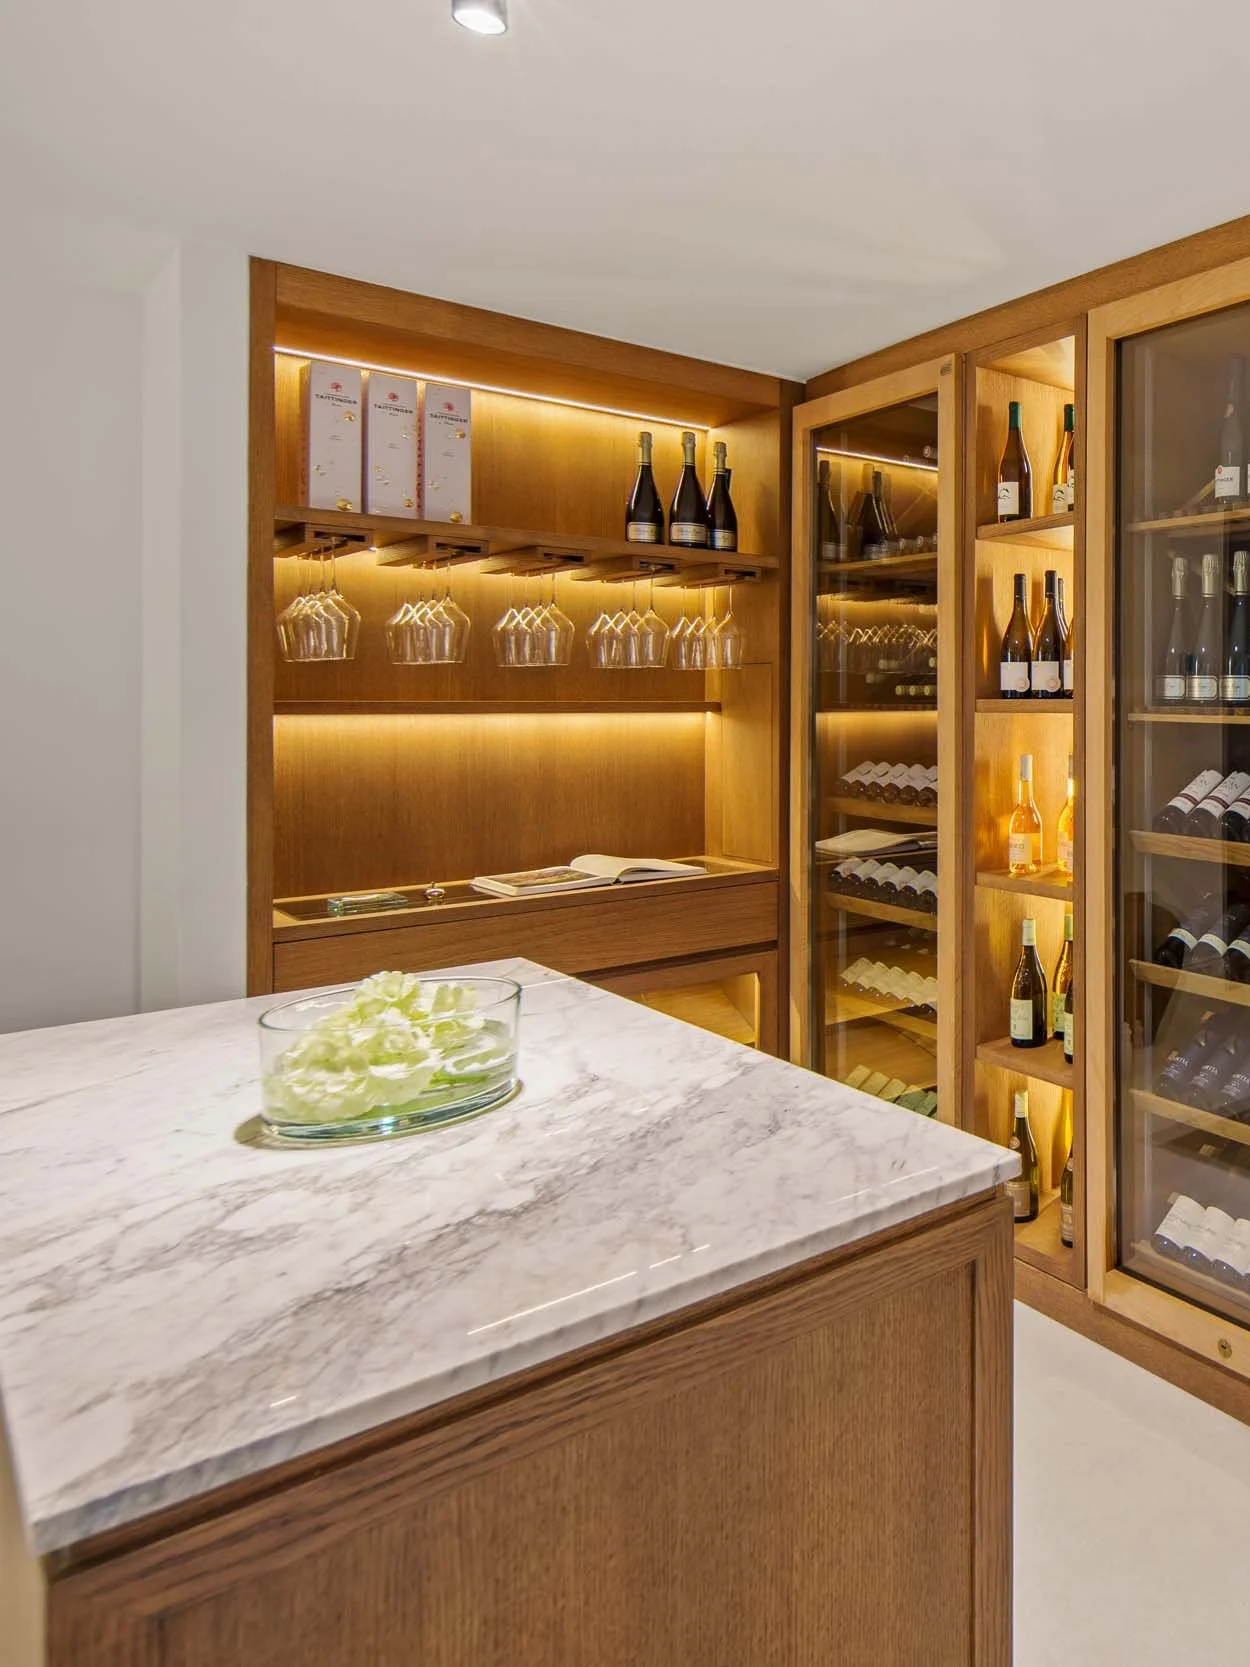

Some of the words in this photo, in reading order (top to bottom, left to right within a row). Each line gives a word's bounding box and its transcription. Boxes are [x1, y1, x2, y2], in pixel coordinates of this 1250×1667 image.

[315, 394, 357, 405] TAITTINGER
[374, 403, 413, 414] TAITTINGER
[429, 413, 468, 424] TAITTINGER
